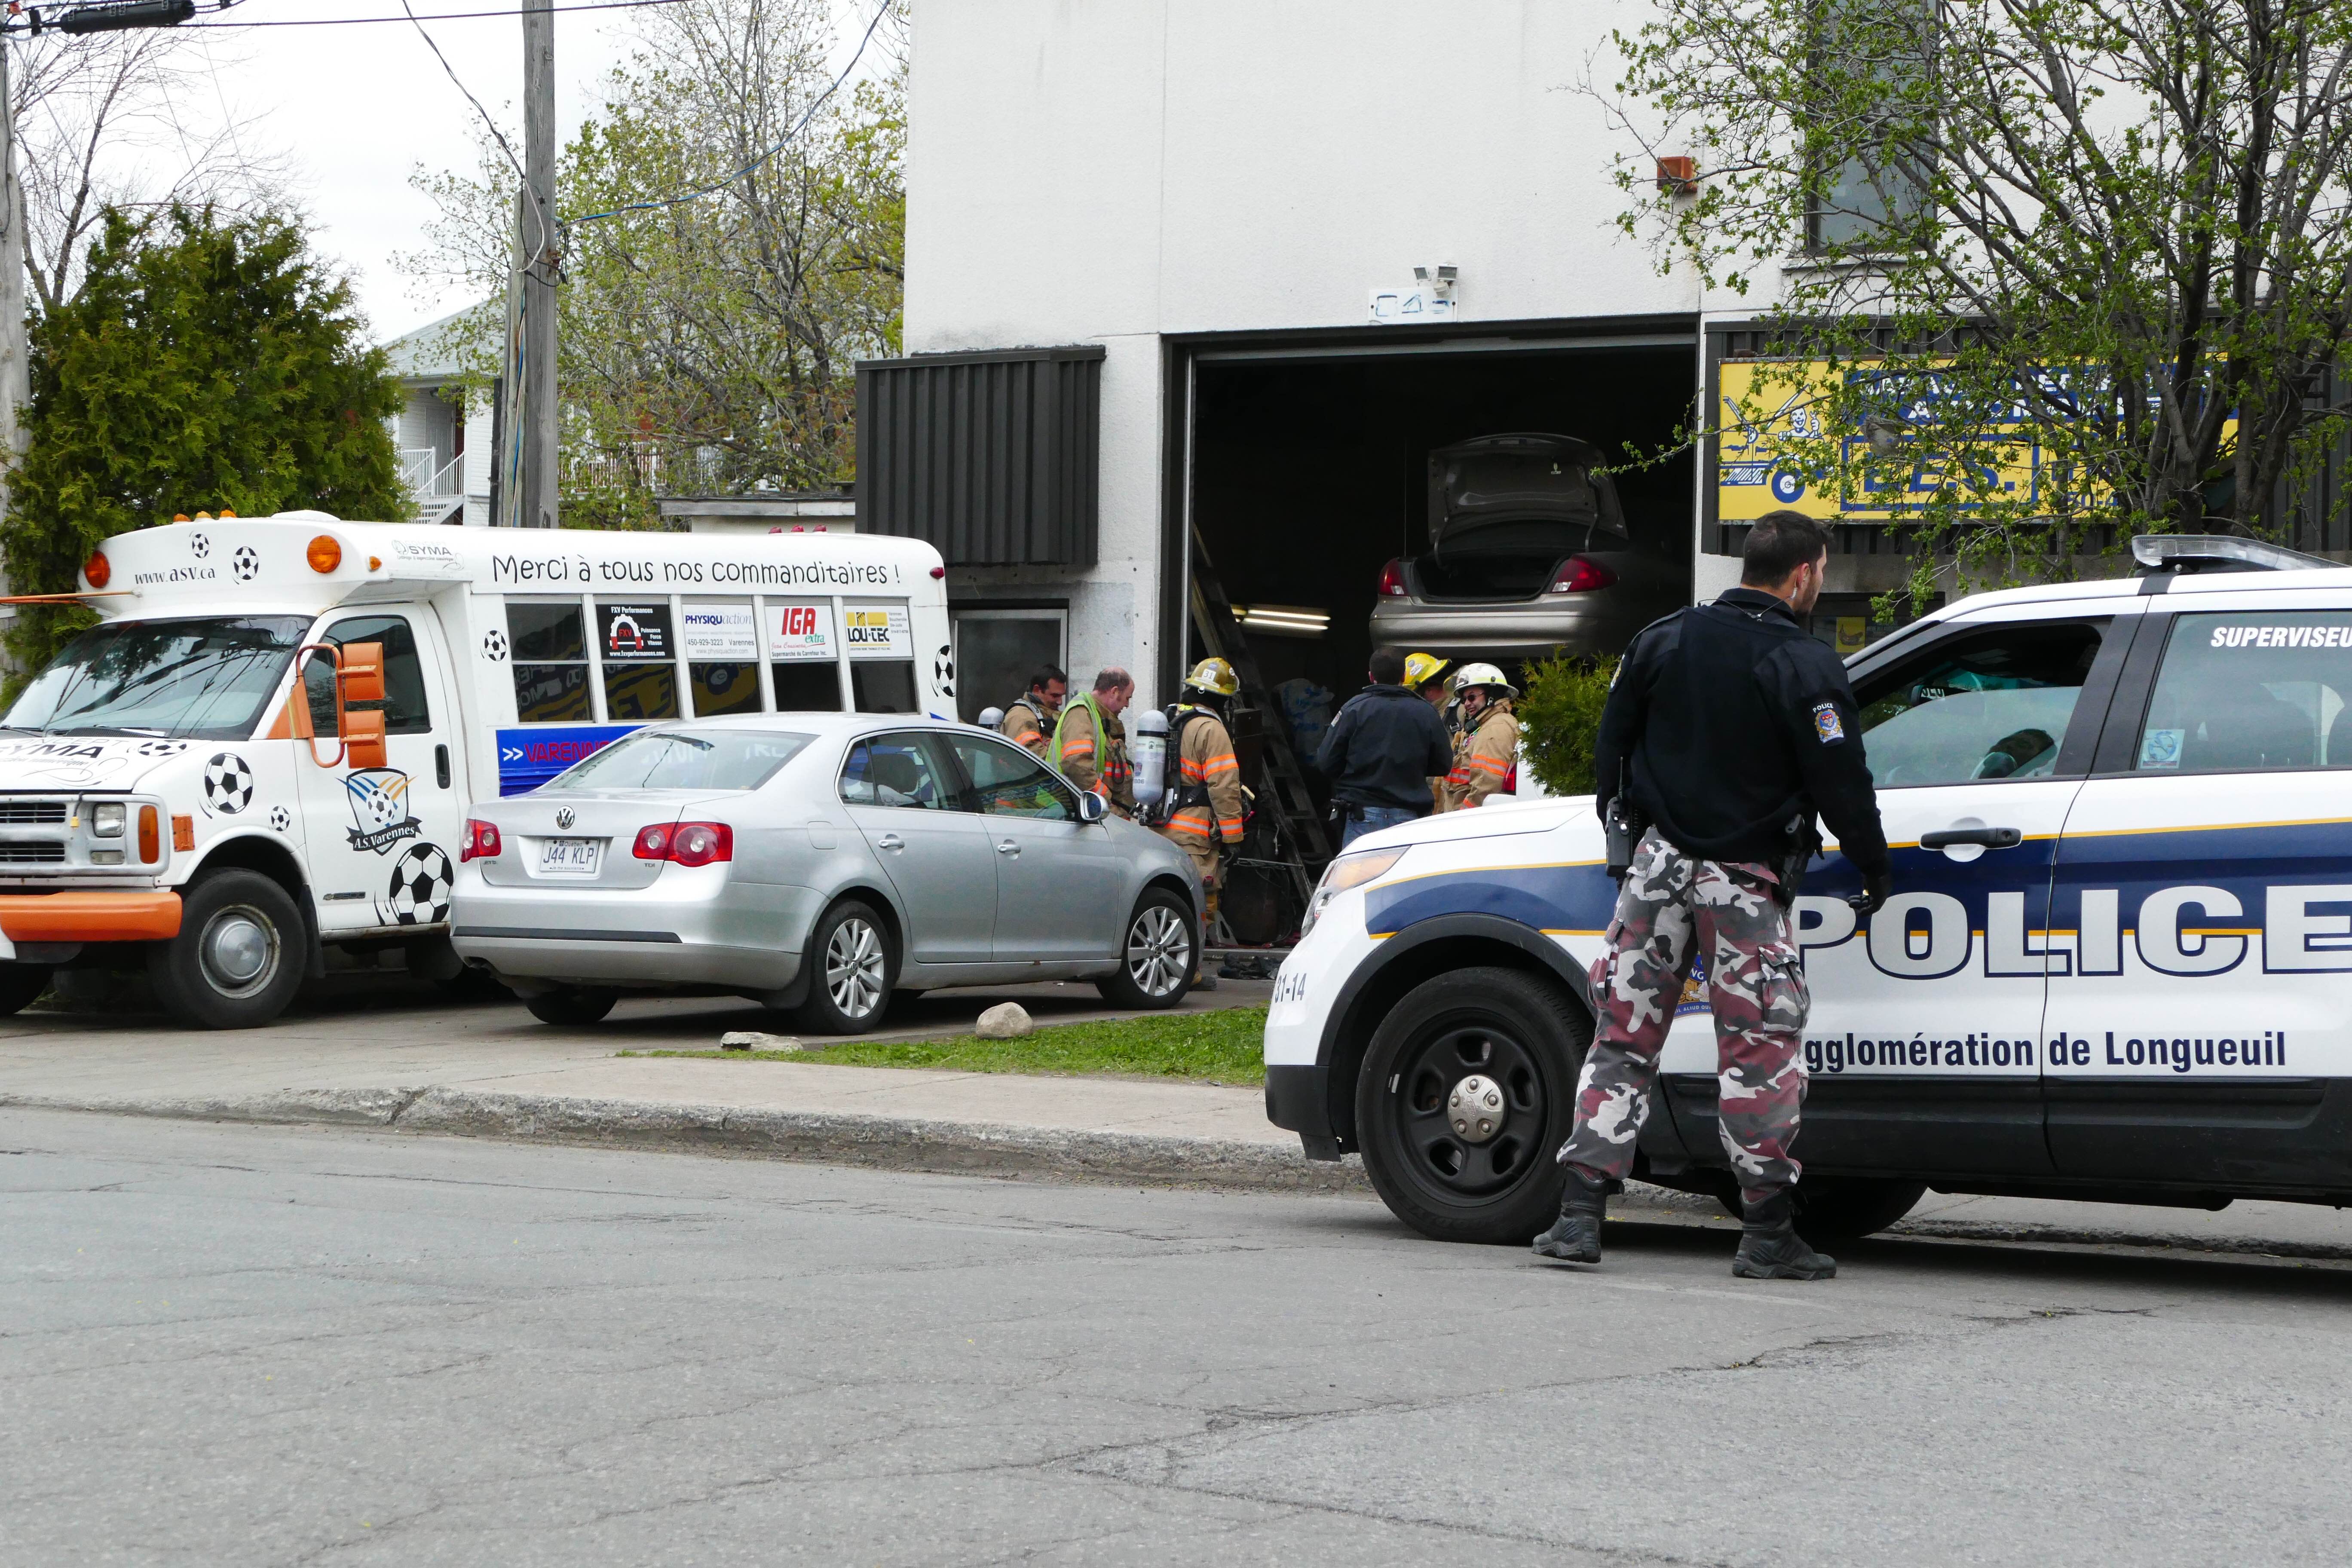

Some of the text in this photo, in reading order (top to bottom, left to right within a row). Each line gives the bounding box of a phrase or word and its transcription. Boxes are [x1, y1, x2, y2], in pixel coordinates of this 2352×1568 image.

[409, 546, 452, 555] SYMA
[135, 567, 216, 584] www.asv.ca
[493, 554, 900, 585] Merci à tous nos commanditaires !
[781, 608, 816, 635] IGA
[805, 633, 825, 643] extra
[2211, 627, 2352, 647] SUPERVISEU
[1204, 671, 1213, 679] 31
[1812, 703, 1834, 713] POLICE
[354, 826, 415, 849] A.S. Varennes
[543, 847, 594, 864] J44 KLP
[1791, 884, 2352, 980] POLICE
[1275, 973, 1307, 1003] 31-14
[1806, 1032, 2285, 1073] gglomération de Longueuil
